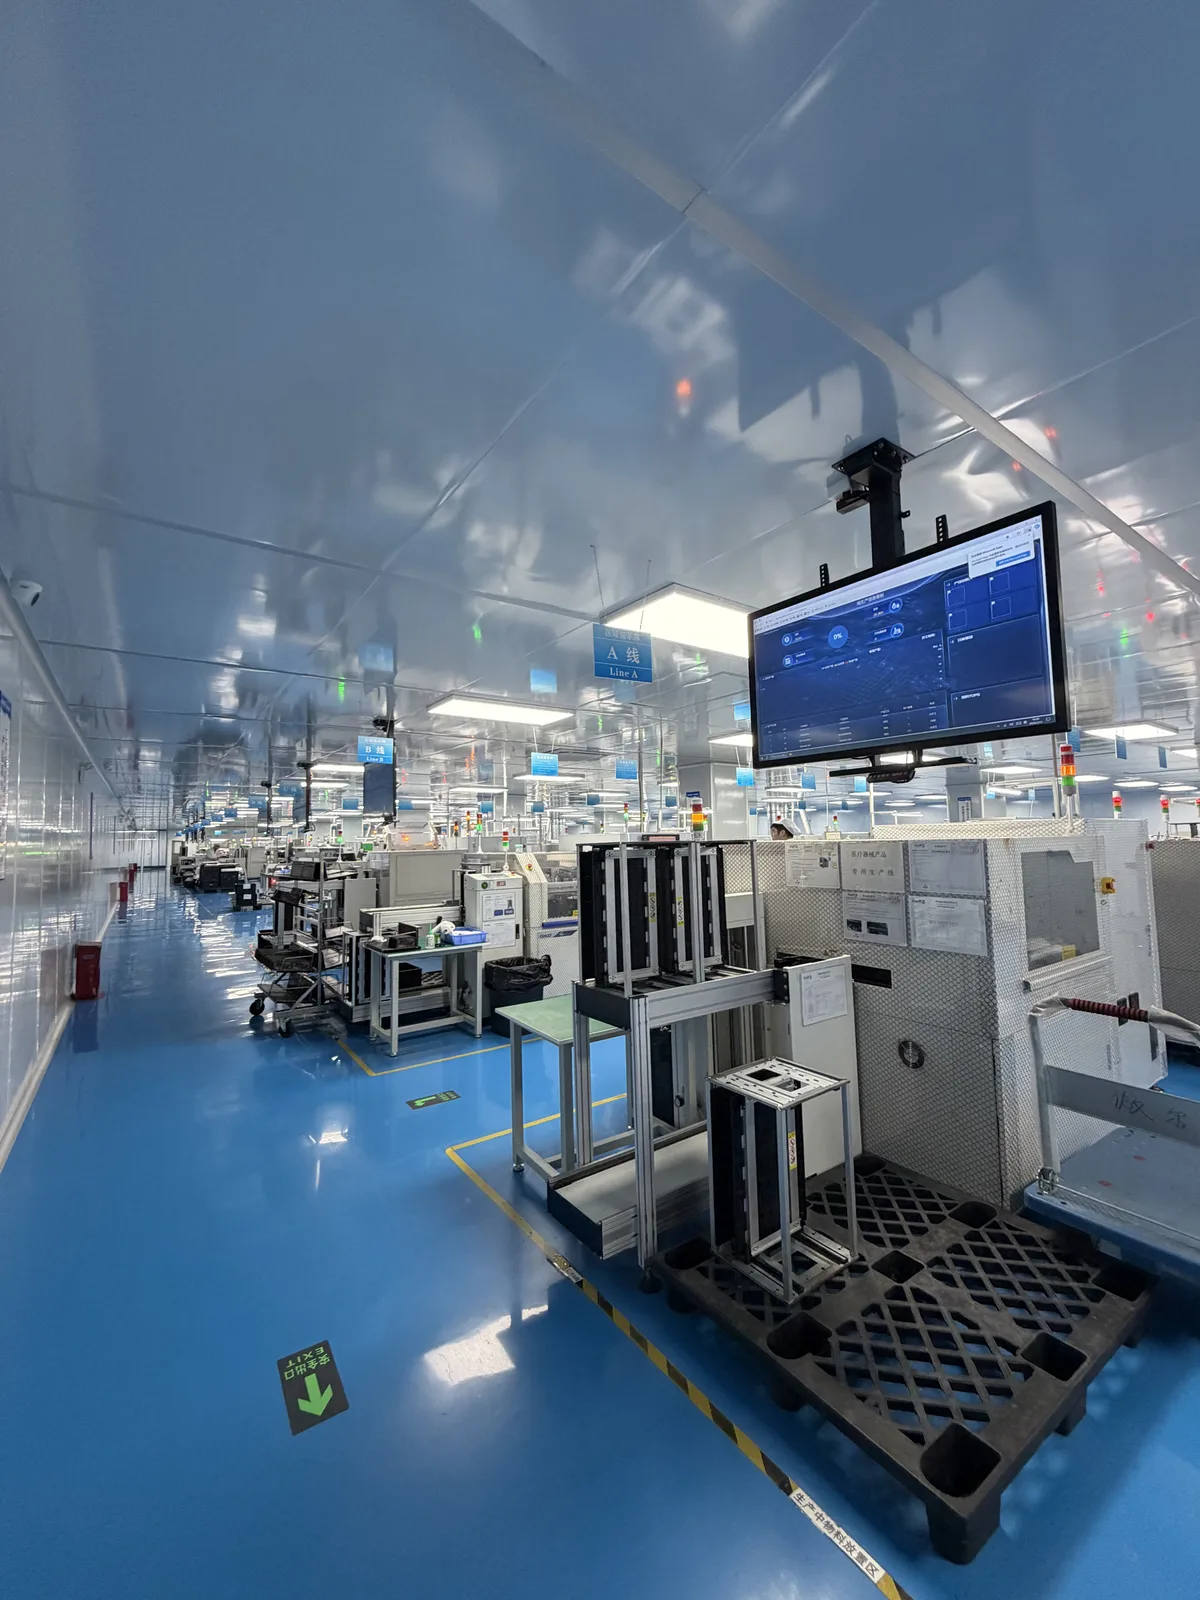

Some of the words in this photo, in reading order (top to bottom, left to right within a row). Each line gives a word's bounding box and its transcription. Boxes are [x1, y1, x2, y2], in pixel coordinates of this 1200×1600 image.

[833, 632, 843, 640] 0%
[607, 646, 618, 659] A
[626, 647, 640, 664] 线
[609, 667, 629, 677] Line
[631, 670, 638, 679] A
[365, 745, 372, 753] B
[376, 745, 385, 755] 线
[852, 868, 894, 877] 专用生产线
[286, 1346, 324, 1368] EXIT
[284, 1353, 330, 1380] 安全出口
[793, 1492, 880, 1578] 生产中物料放置区
